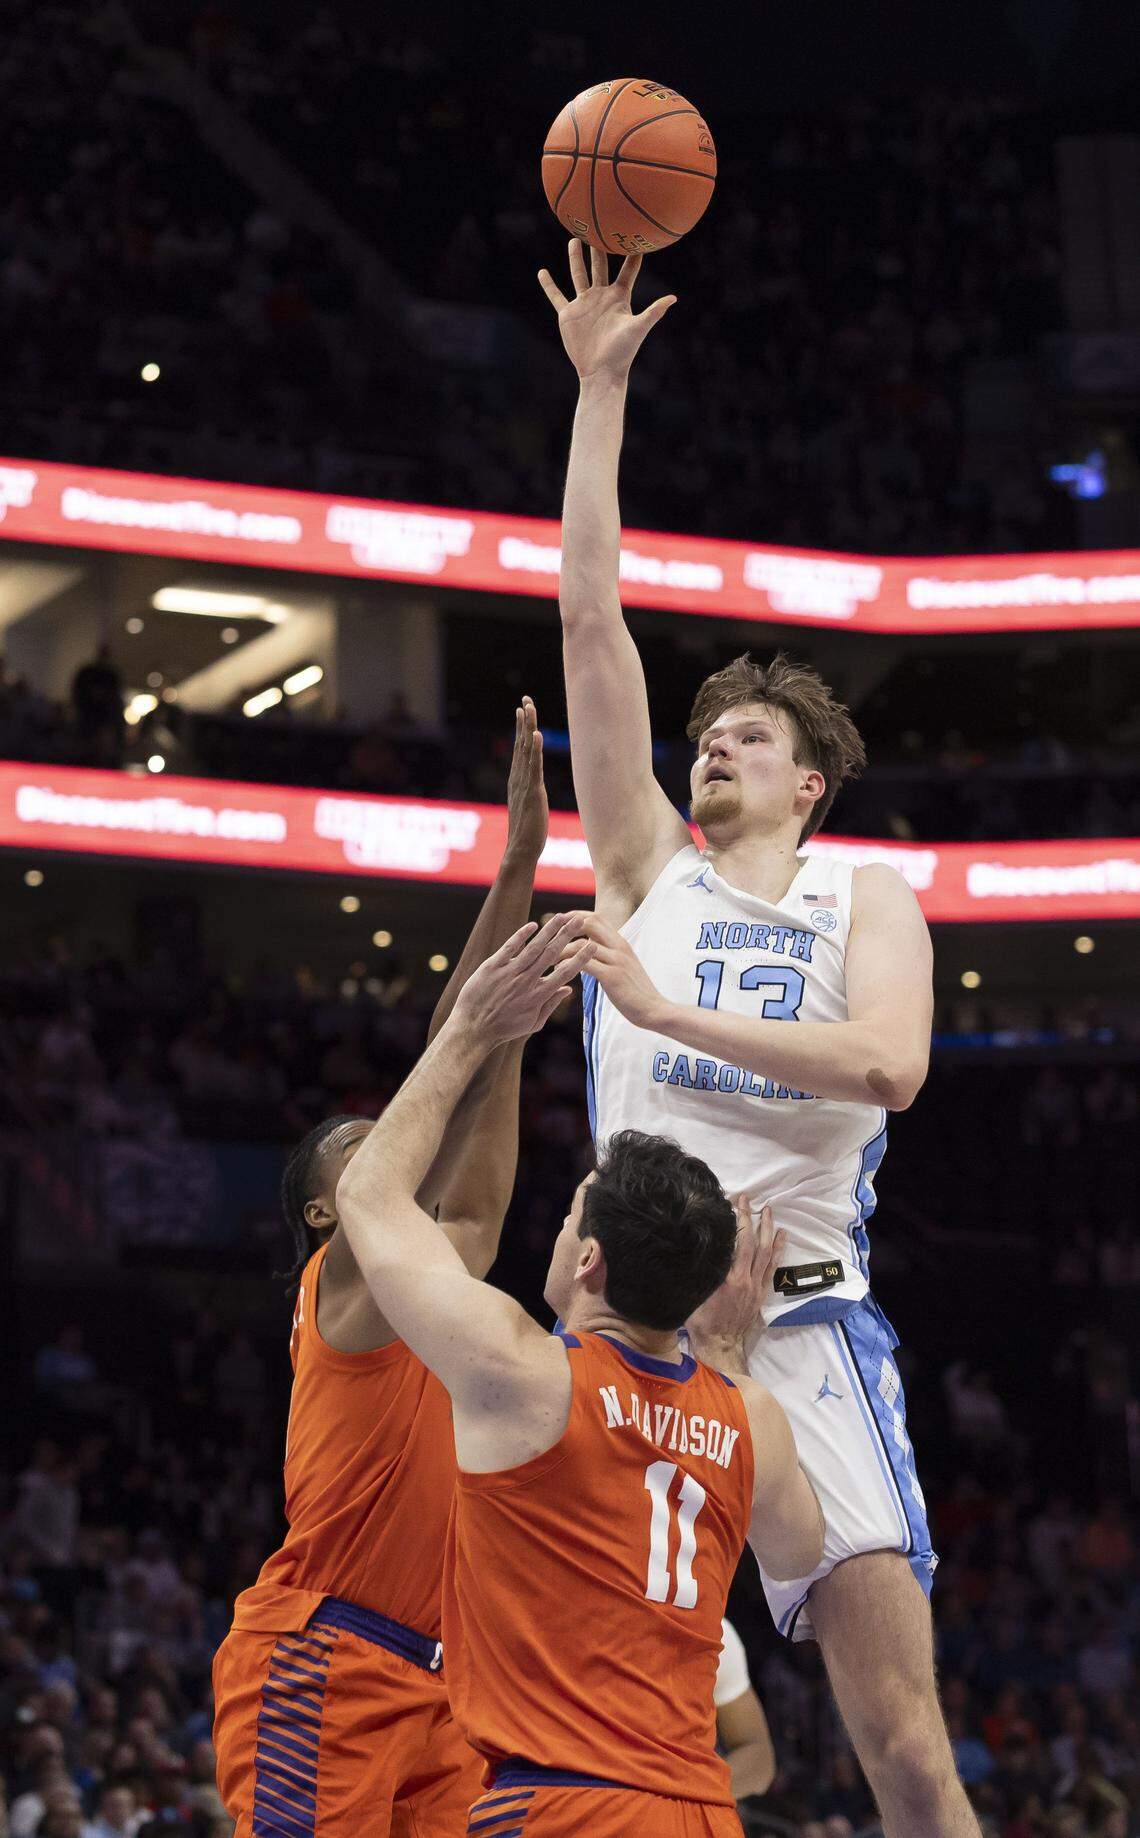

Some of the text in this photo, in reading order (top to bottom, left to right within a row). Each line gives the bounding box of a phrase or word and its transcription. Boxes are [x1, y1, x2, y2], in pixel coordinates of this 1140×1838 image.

[696, 921, 816, 963] NORTH
[695, 959, 806, 1022] 13
[652, 1051, 822, 1100] CAROLI
[825, 1266, 839, 1277] 50
[644, 1460, 706, 1609] 11
